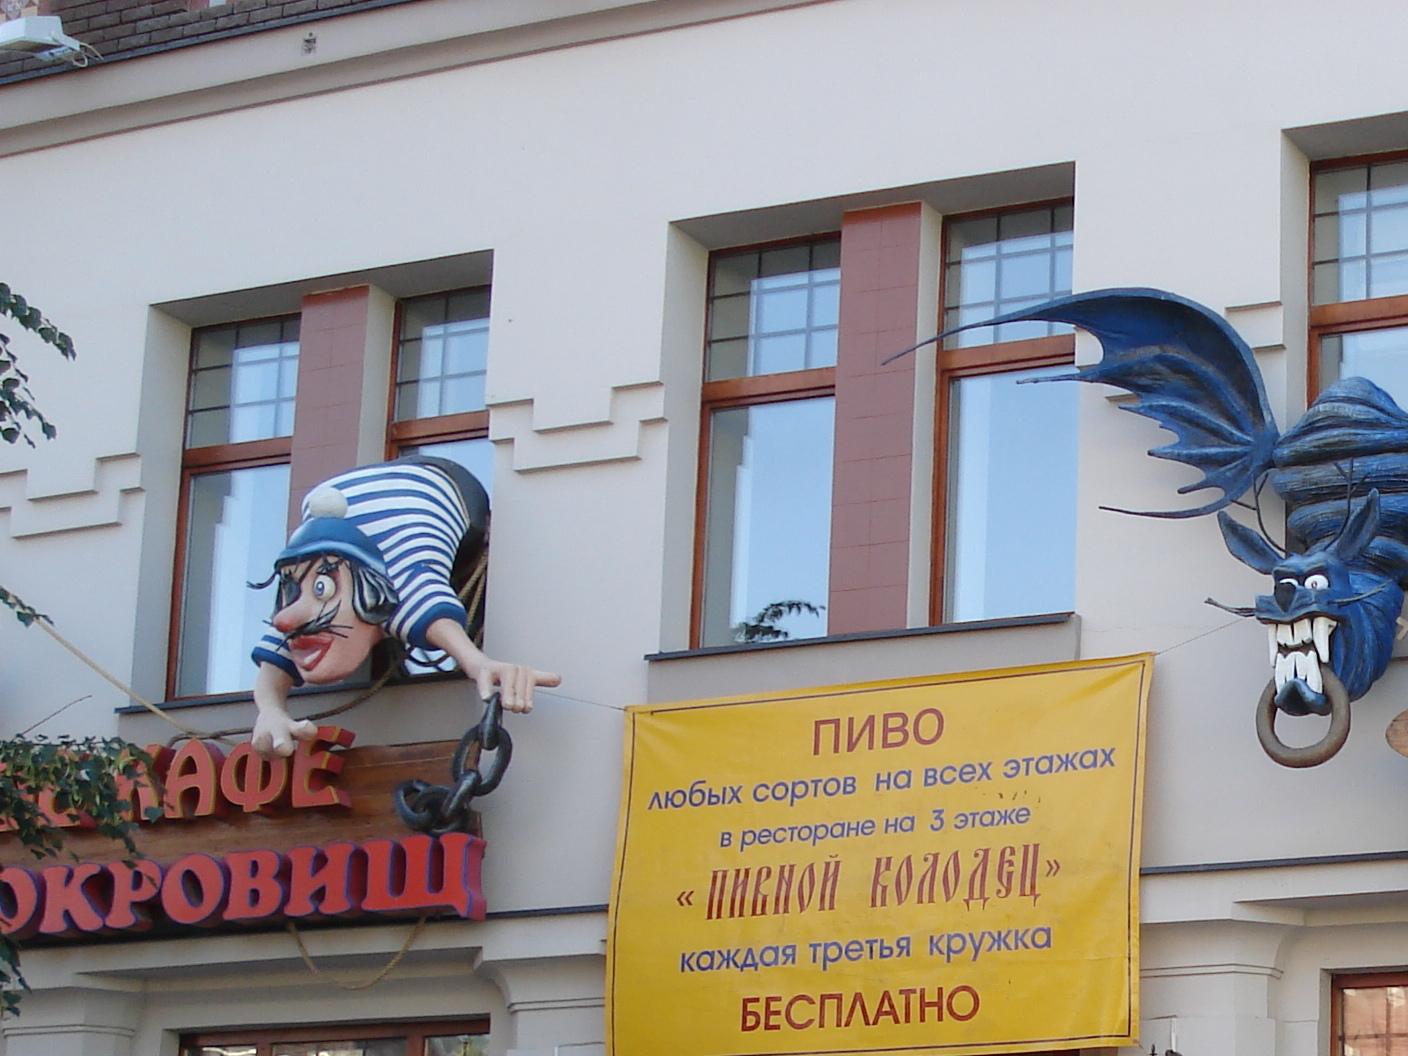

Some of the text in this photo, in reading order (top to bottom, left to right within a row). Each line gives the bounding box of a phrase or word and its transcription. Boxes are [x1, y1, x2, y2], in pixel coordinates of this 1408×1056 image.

[812, 708, 944, 756] ПИВО
[648, 747, 1116, 811] любых сортов на всех этажах
[720, 805, 1031, 852] в ресторане на 3 этаже
[679, 924, 1052, 974] каждая третья кружка
[740, 985, 981, 1032] БЕСПЛАТНО
